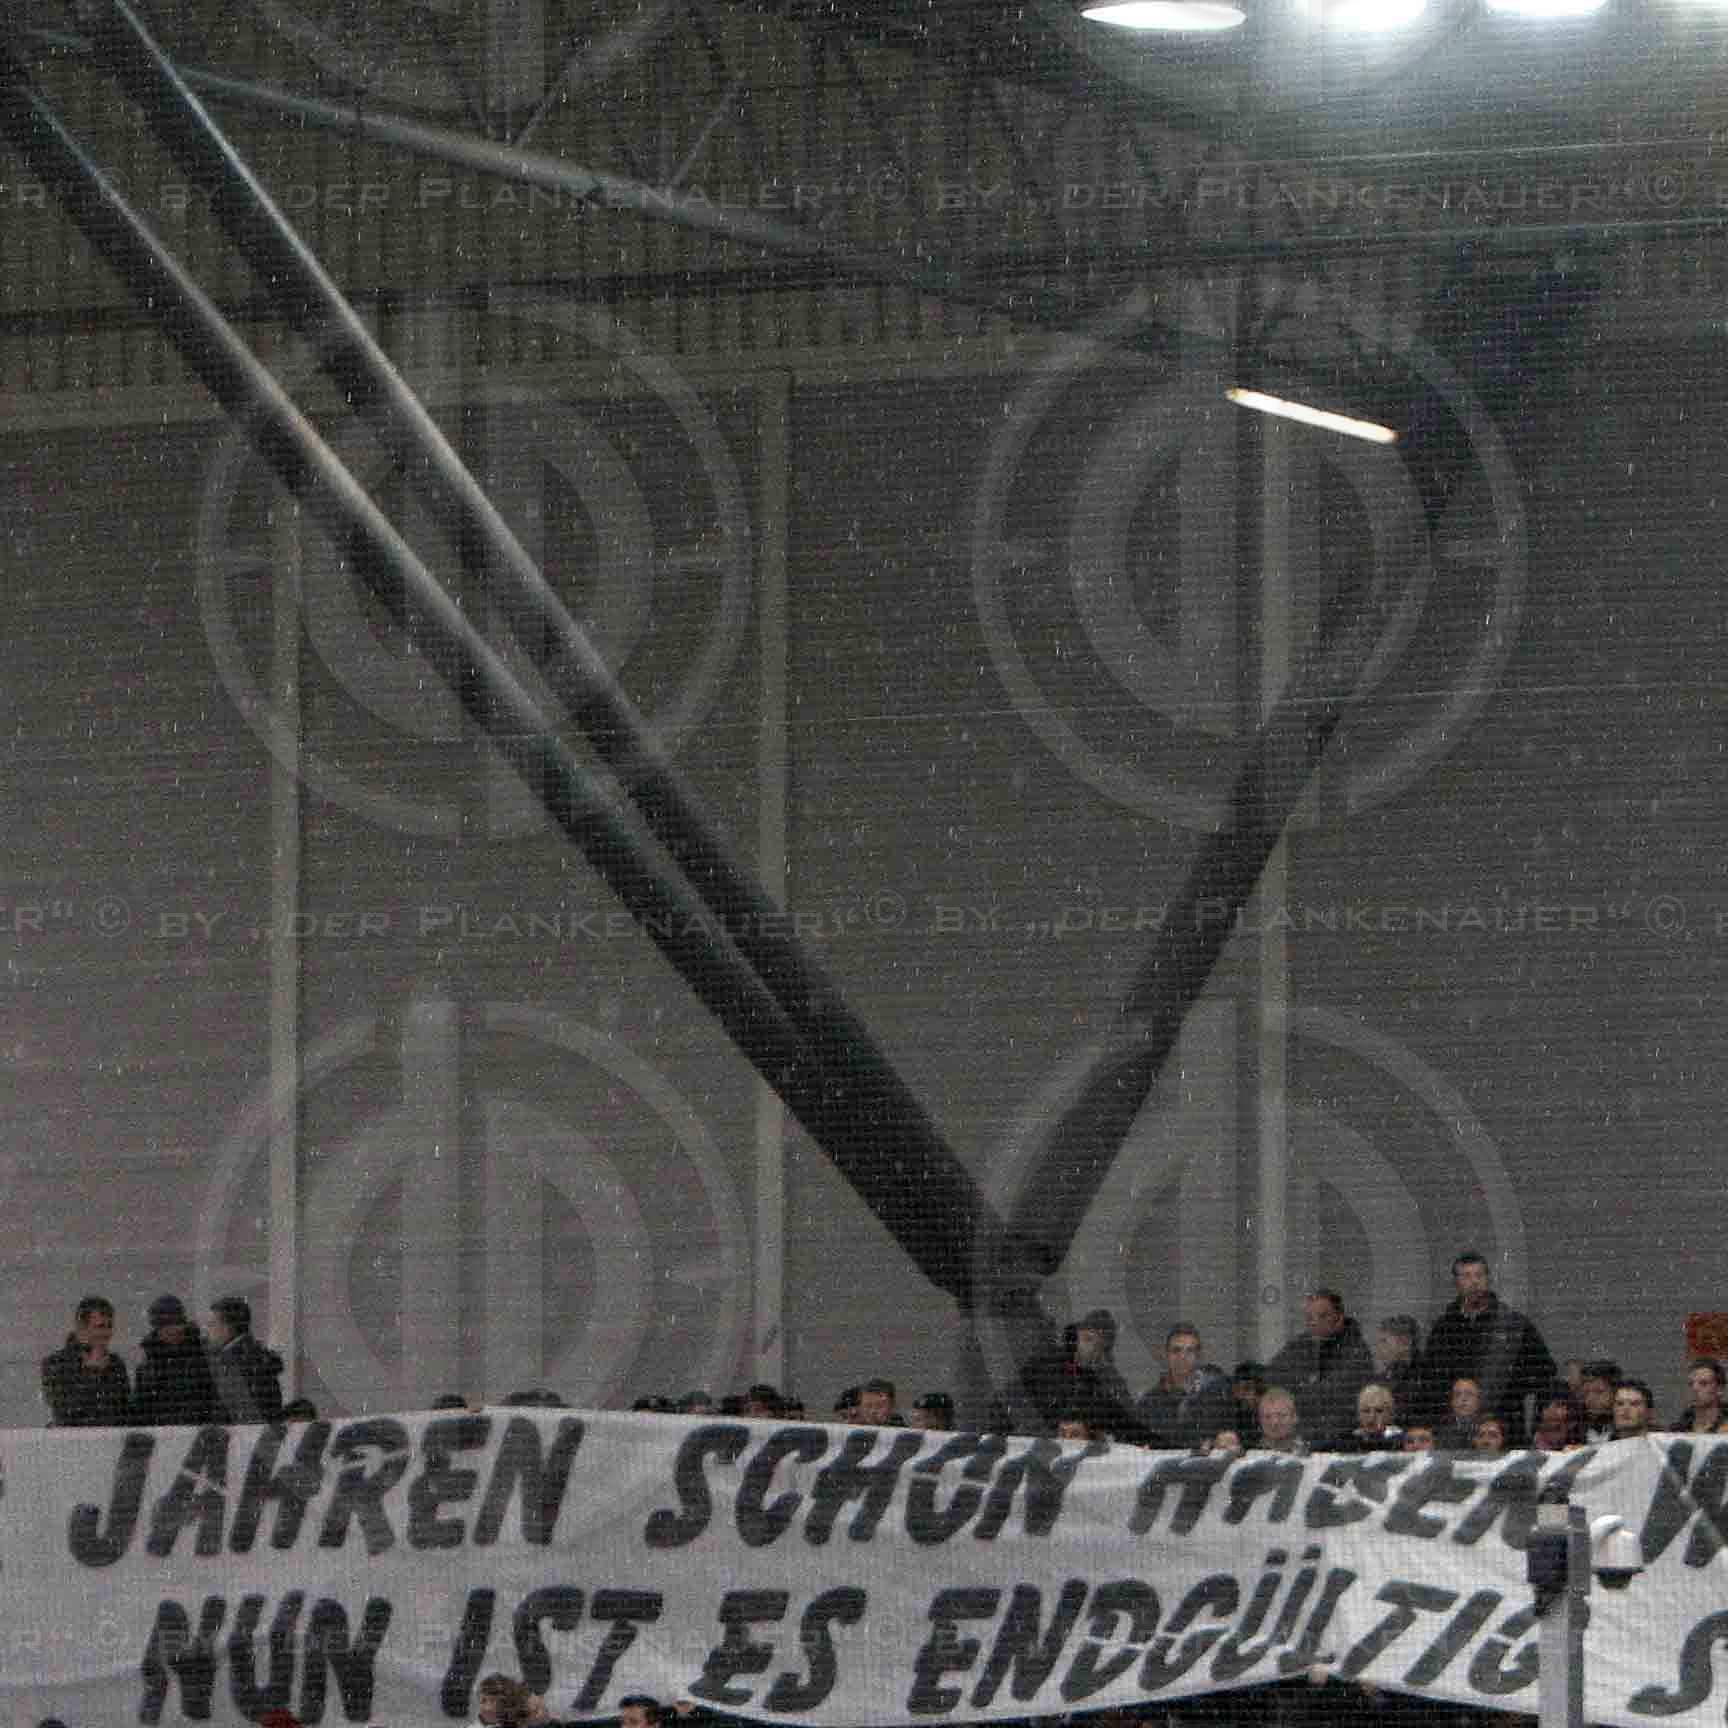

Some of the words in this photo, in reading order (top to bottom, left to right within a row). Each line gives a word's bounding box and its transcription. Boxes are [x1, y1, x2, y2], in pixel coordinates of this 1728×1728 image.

[70, 1416, 583, 1567] JAHREN
[645, 1423, 1083, 1547] SCHON
[139, 1596, 392, 1725] NUN
[442, 1589, 663, 1720] IST
[687, 1587, 866, 1714] ES
